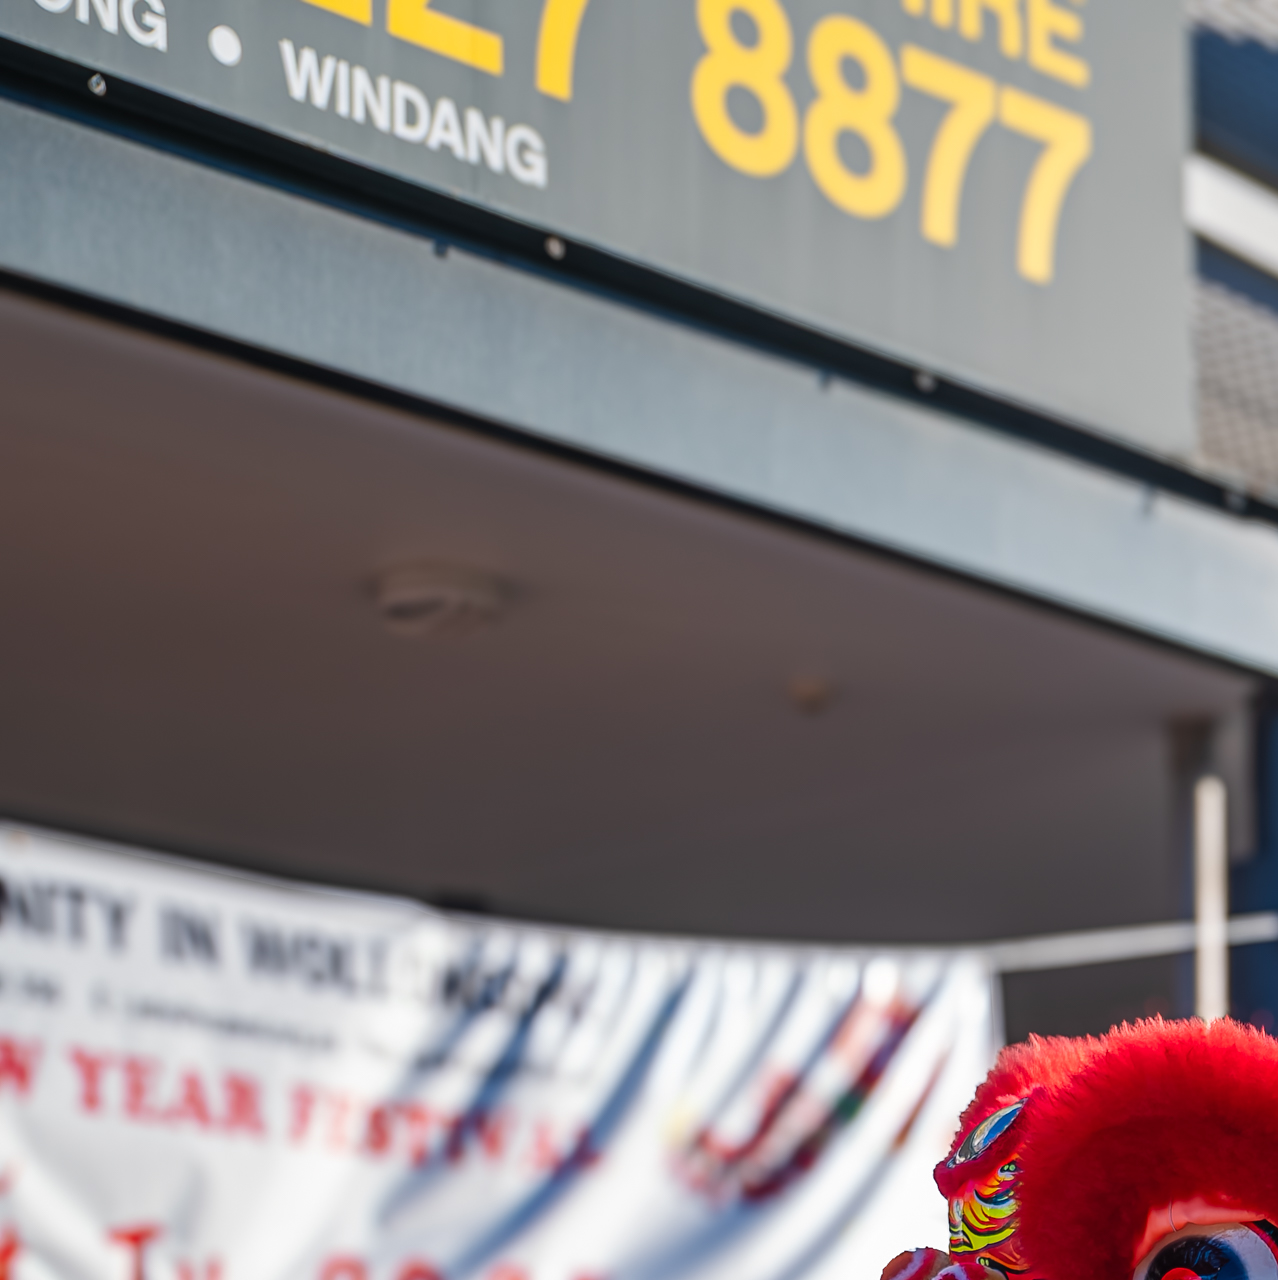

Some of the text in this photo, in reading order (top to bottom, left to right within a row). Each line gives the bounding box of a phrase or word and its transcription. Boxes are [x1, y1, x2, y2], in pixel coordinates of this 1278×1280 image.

[280, 38, 548, 189] WINDANG
[690, 0, 1093, 287] 8877
[66, 1040, 265, 1136] YEAR
